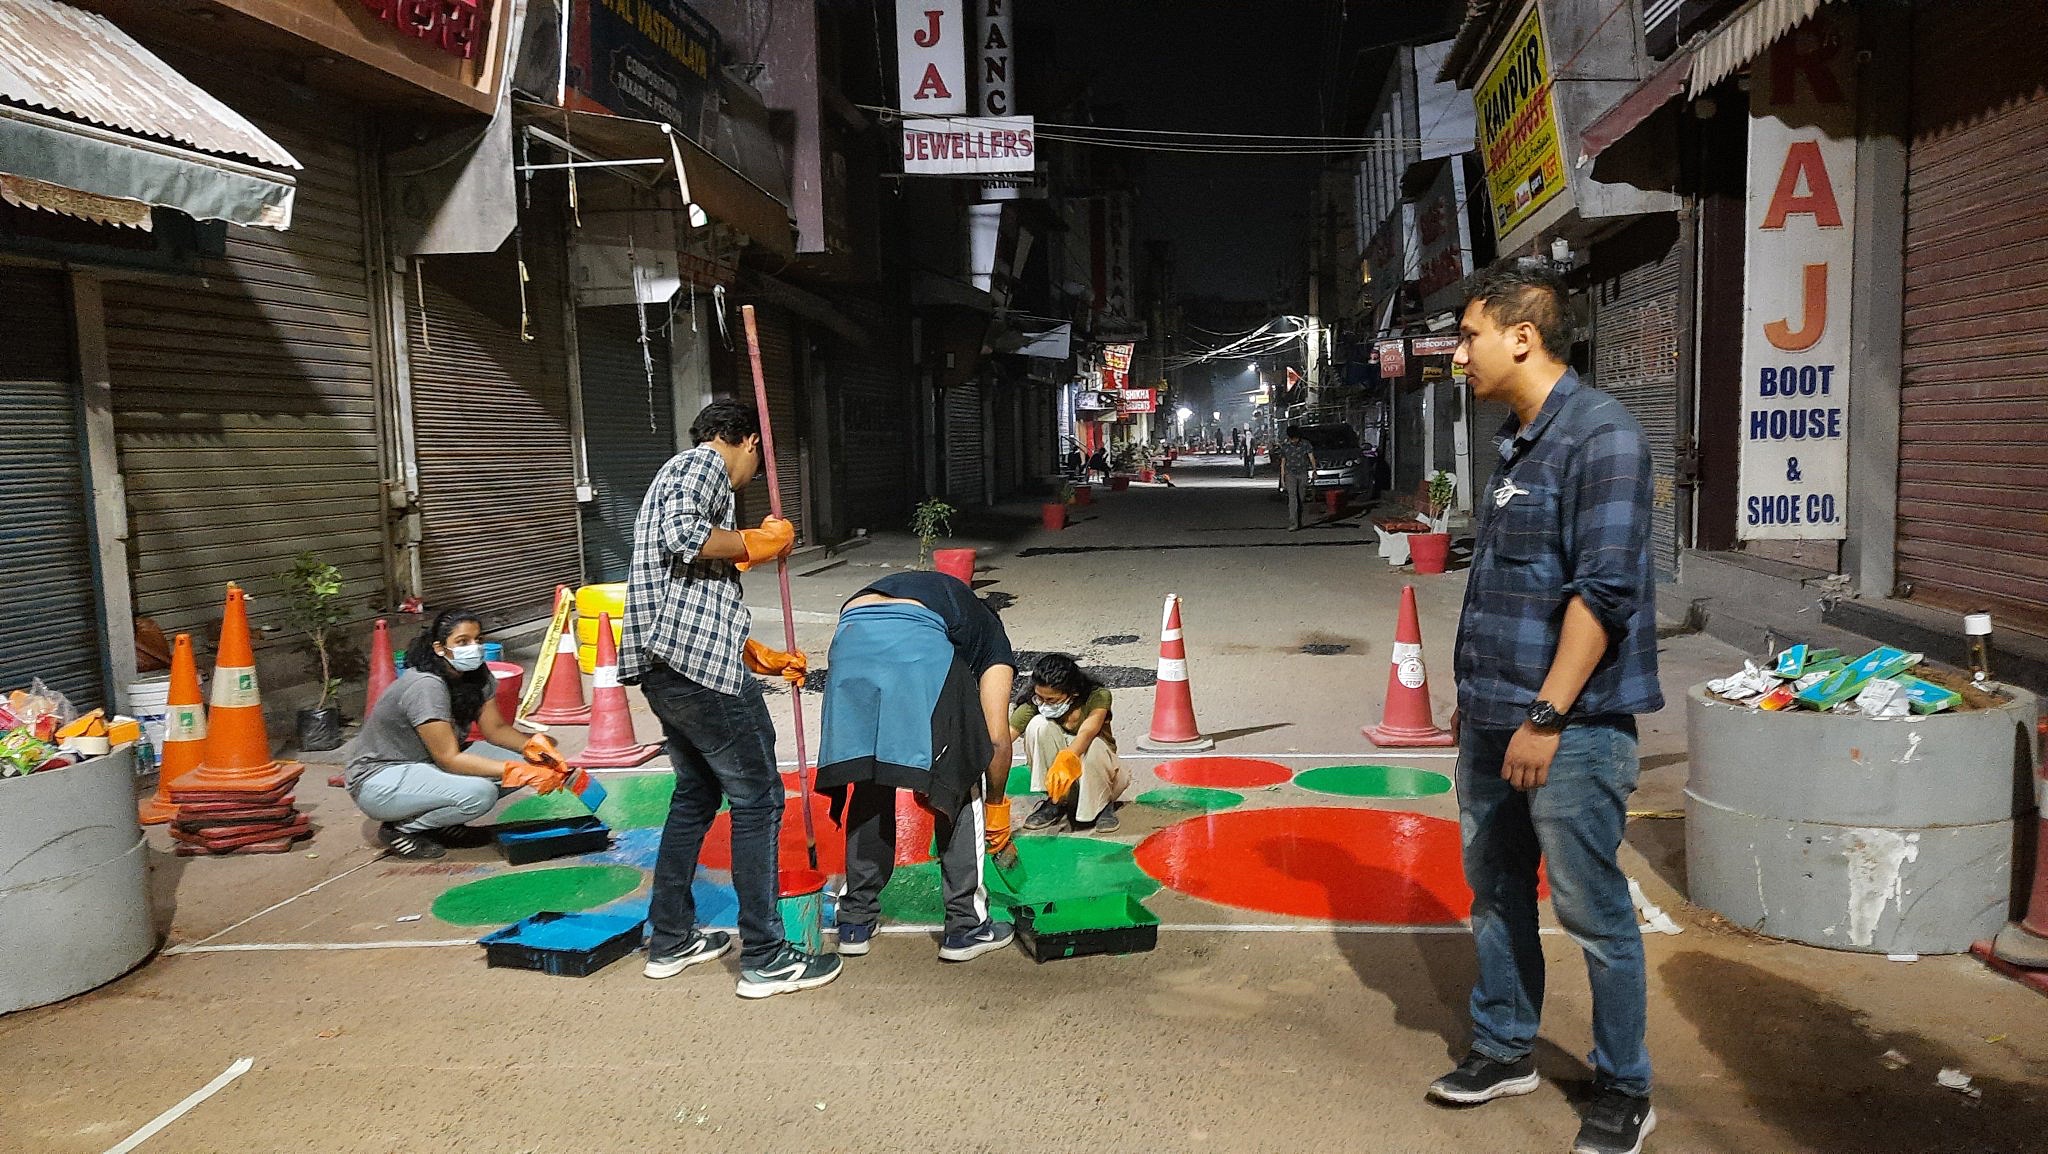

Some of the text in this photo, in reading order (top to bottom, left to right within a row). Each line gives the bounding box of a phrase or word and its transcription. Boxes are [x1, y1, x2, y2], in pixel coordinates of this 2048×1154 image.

[1484, 34, 1542, 145] KANPUR
[904, 129, 1034, 161] JEWELLERS
[1126, 389, 1150, 399] SHIKHA
[1759, 366, 1834, 397] BOOT
[1750, 408, 1840, 440] HOUSE
[1786, 456, 1801, 482] &
[1747, 494, 1840, 526] SHOE CO.
